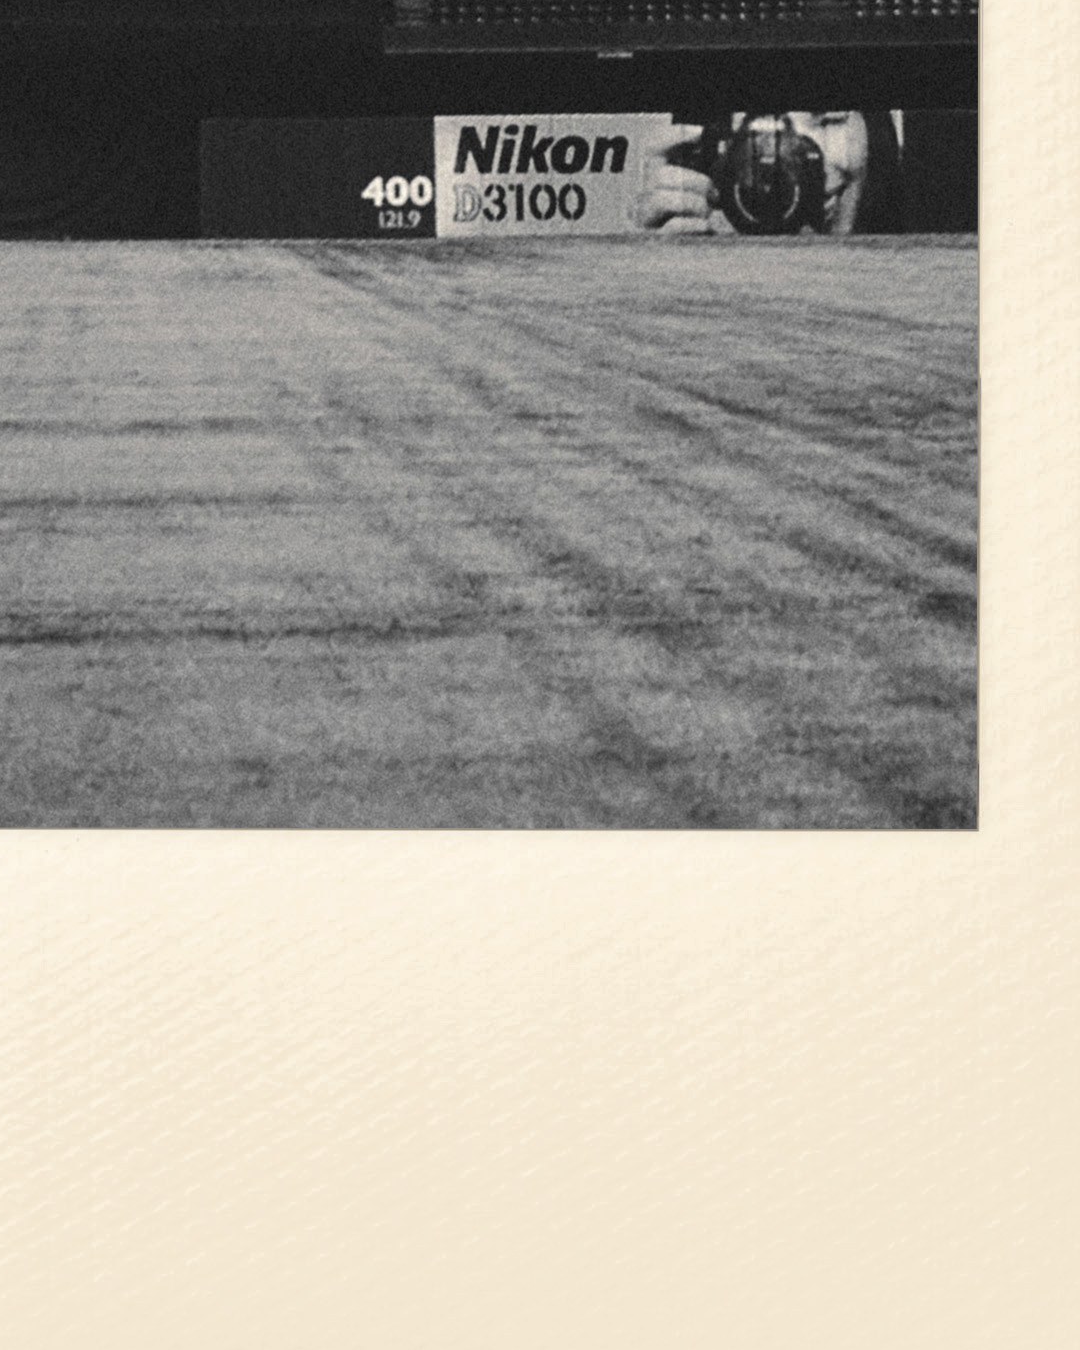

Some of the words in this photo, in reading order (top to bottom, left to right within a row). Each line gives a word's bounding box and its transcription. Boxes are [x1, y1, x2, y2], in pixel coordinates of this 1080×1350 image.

[453, 124, 630, 175] Nikon
[360, 175, 433, 207] 400
[453, 182, 587, 222] D3100
